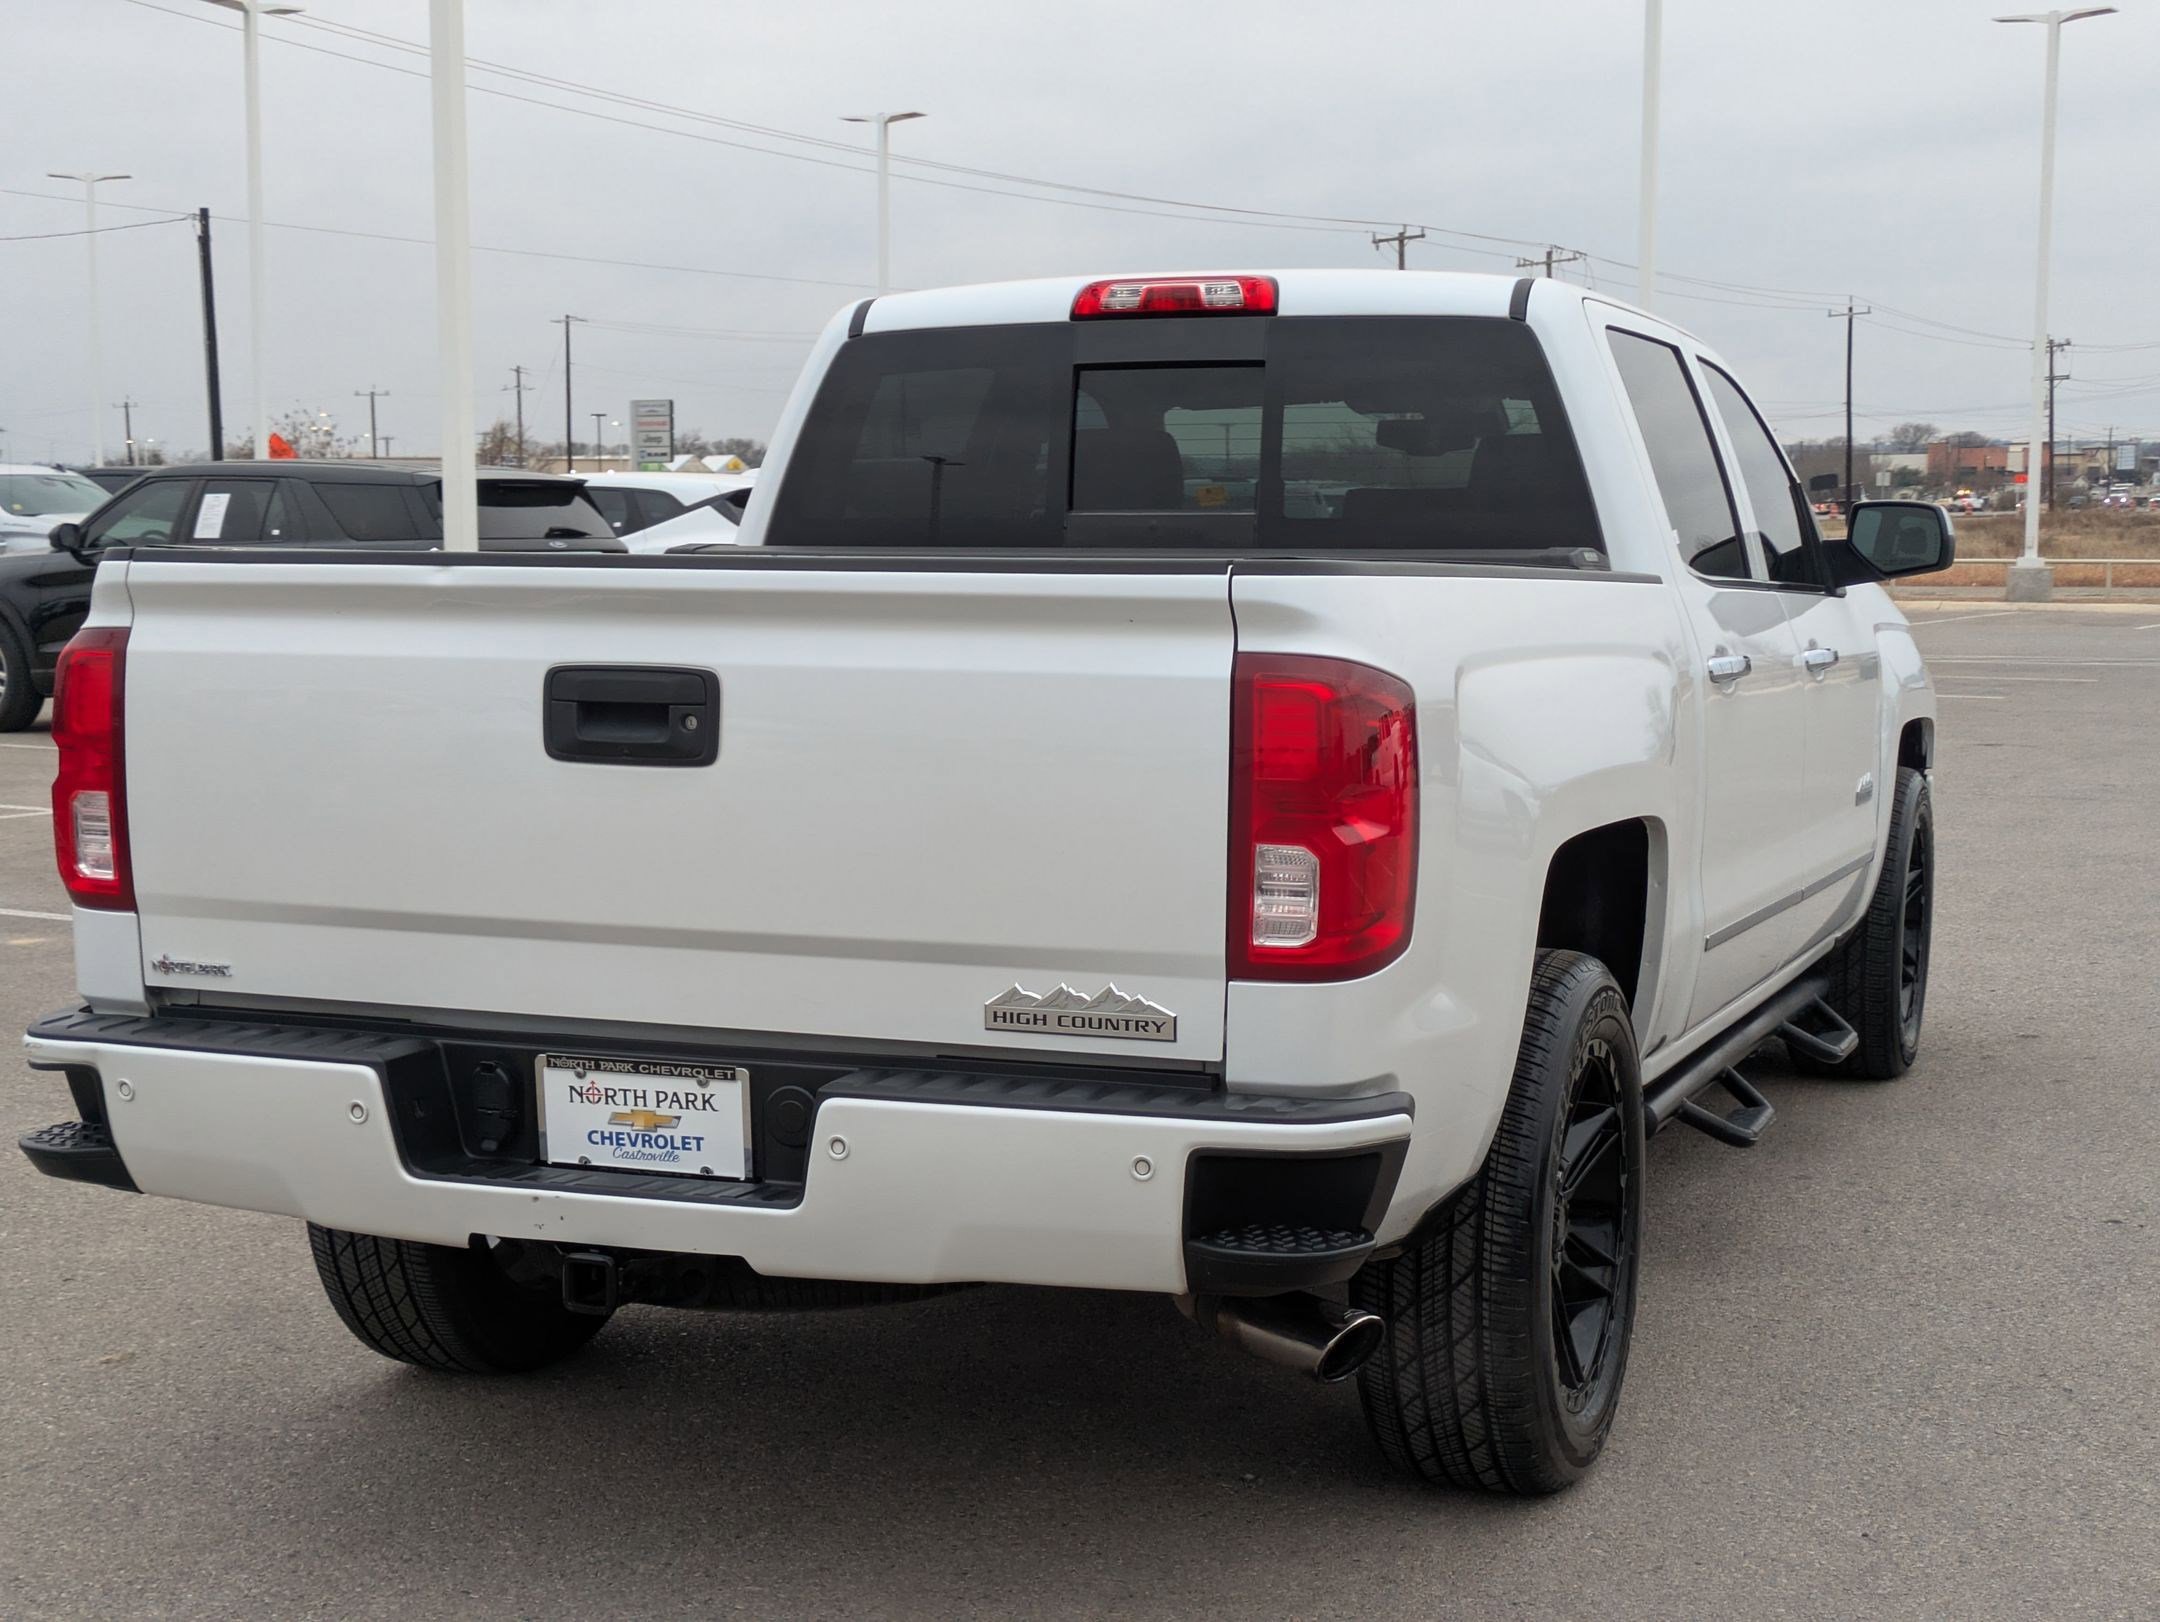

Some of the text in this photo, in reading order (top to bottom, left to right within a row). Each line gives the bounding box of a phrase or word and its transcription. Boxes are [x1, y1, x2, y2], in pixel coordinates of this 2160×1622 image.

[992, 1010, 1167, 1034] HIGH COUNTRY
[550, 1057, 735, 1080] NORTH PARK CHEVROLET
[568, 1080, 719, 1112] NORTH PARK
[587, 1130, 705, 1152] CHEVROLET
[612, 1146, 681, 1163] Castroville
